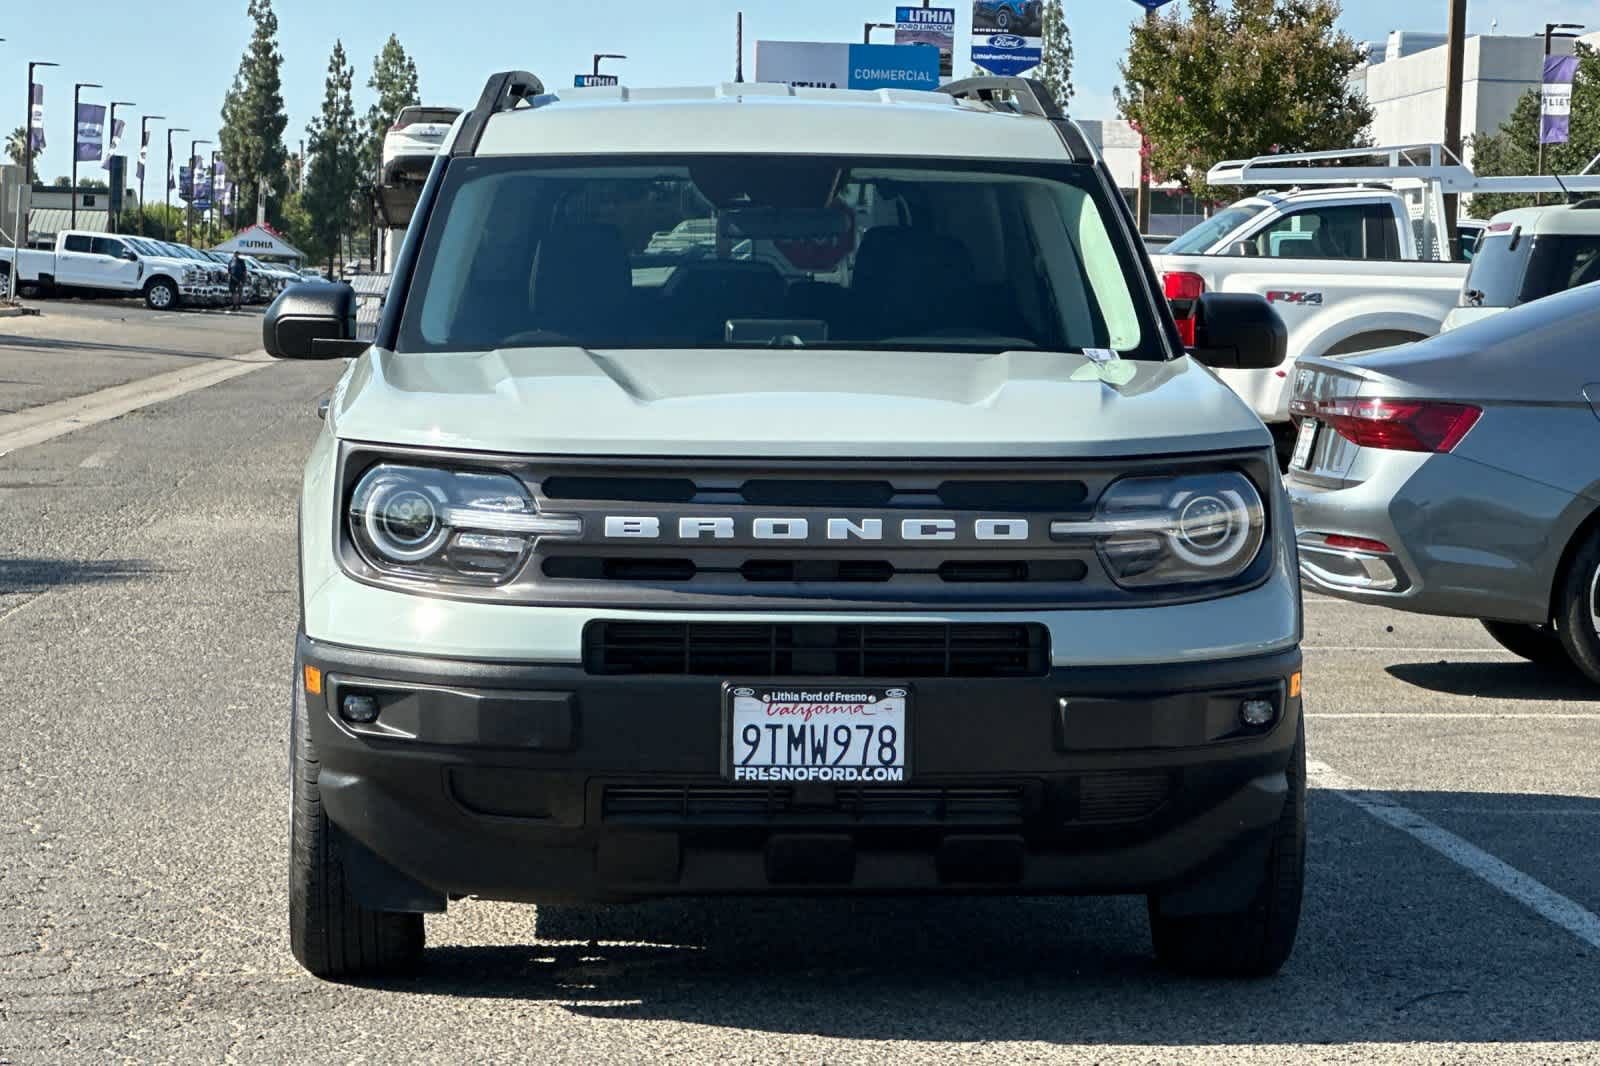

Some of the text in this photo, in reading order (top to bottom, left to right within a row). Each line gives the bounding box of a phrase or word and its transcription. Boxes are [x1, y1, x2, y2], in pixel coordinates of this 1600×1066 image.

[909, 10, 953, 23] LITHIA
[994, 36, 1020, 47] Ford
[854, 68, 933, 82] COMMERCIAL
[246, 240, 273, 249] LITHIA
[1266, 291, 1322, 304] FX4
[604, 515, 1029, 541] BRONCO
[771, 691, 867, 702] Lithia Ford of Fresno
[766, 702, 878, 722] California
[741, 724, 897, 766] 9TMW978
[734, 766, 903, 781] FRESNOFORD.COM
